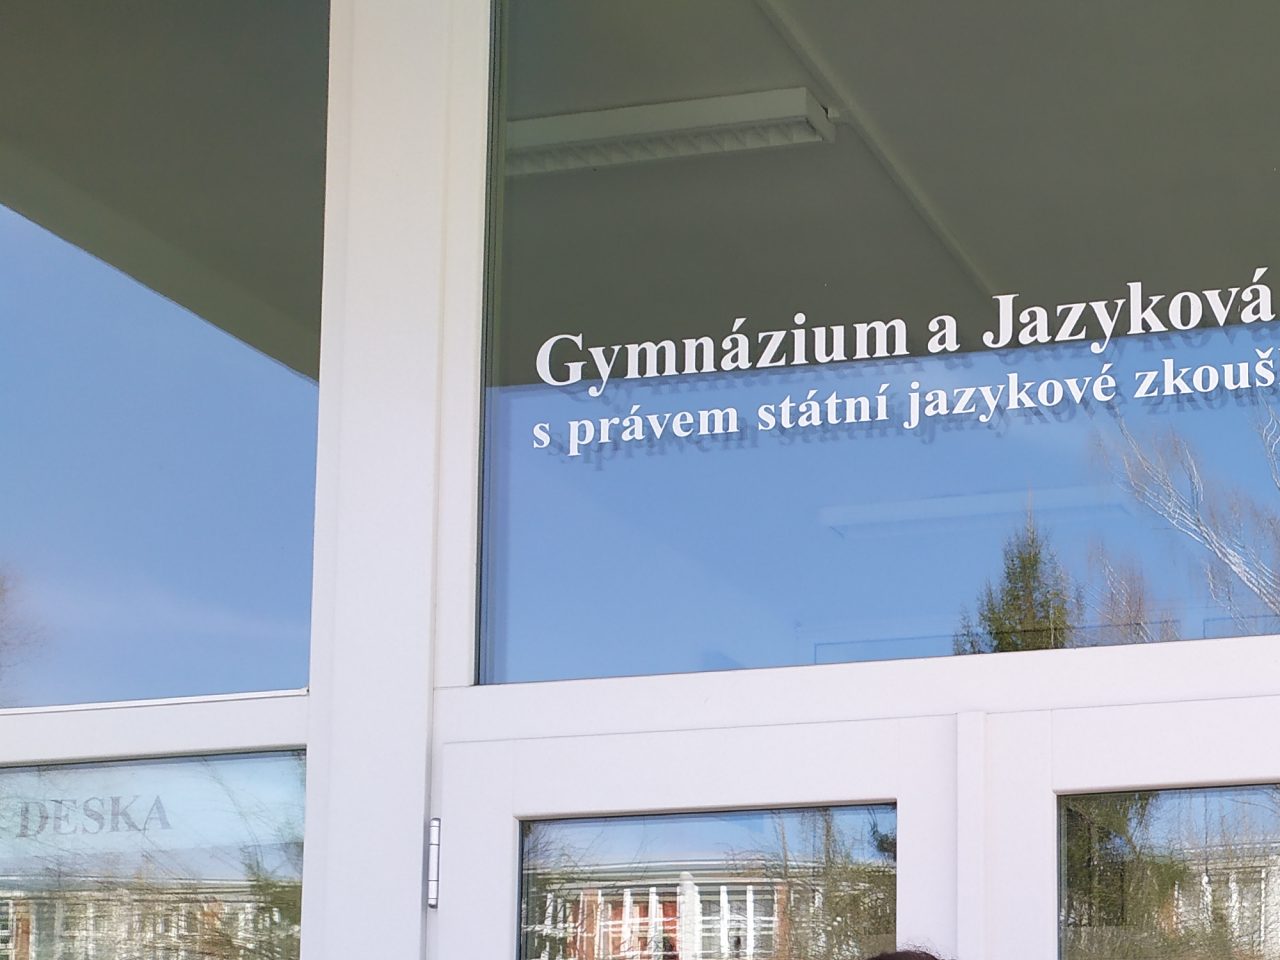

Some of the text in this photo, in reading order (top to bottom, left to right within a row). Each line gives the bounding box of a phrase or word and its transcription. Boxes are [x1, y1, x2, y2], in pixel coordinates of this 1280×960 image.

[535, 312, 909, 397] Gymnázium
[927, 313, 960, 354] a
[982, 267, 1275, 353] Jazyková
[532, 421, 551, 449] s
[567, 405, 740, 457] právem
[757, 383, 890, 432] státní
[903, 362, 1117, 430] jazykové
[16, 795, 172, 838] DESKA
